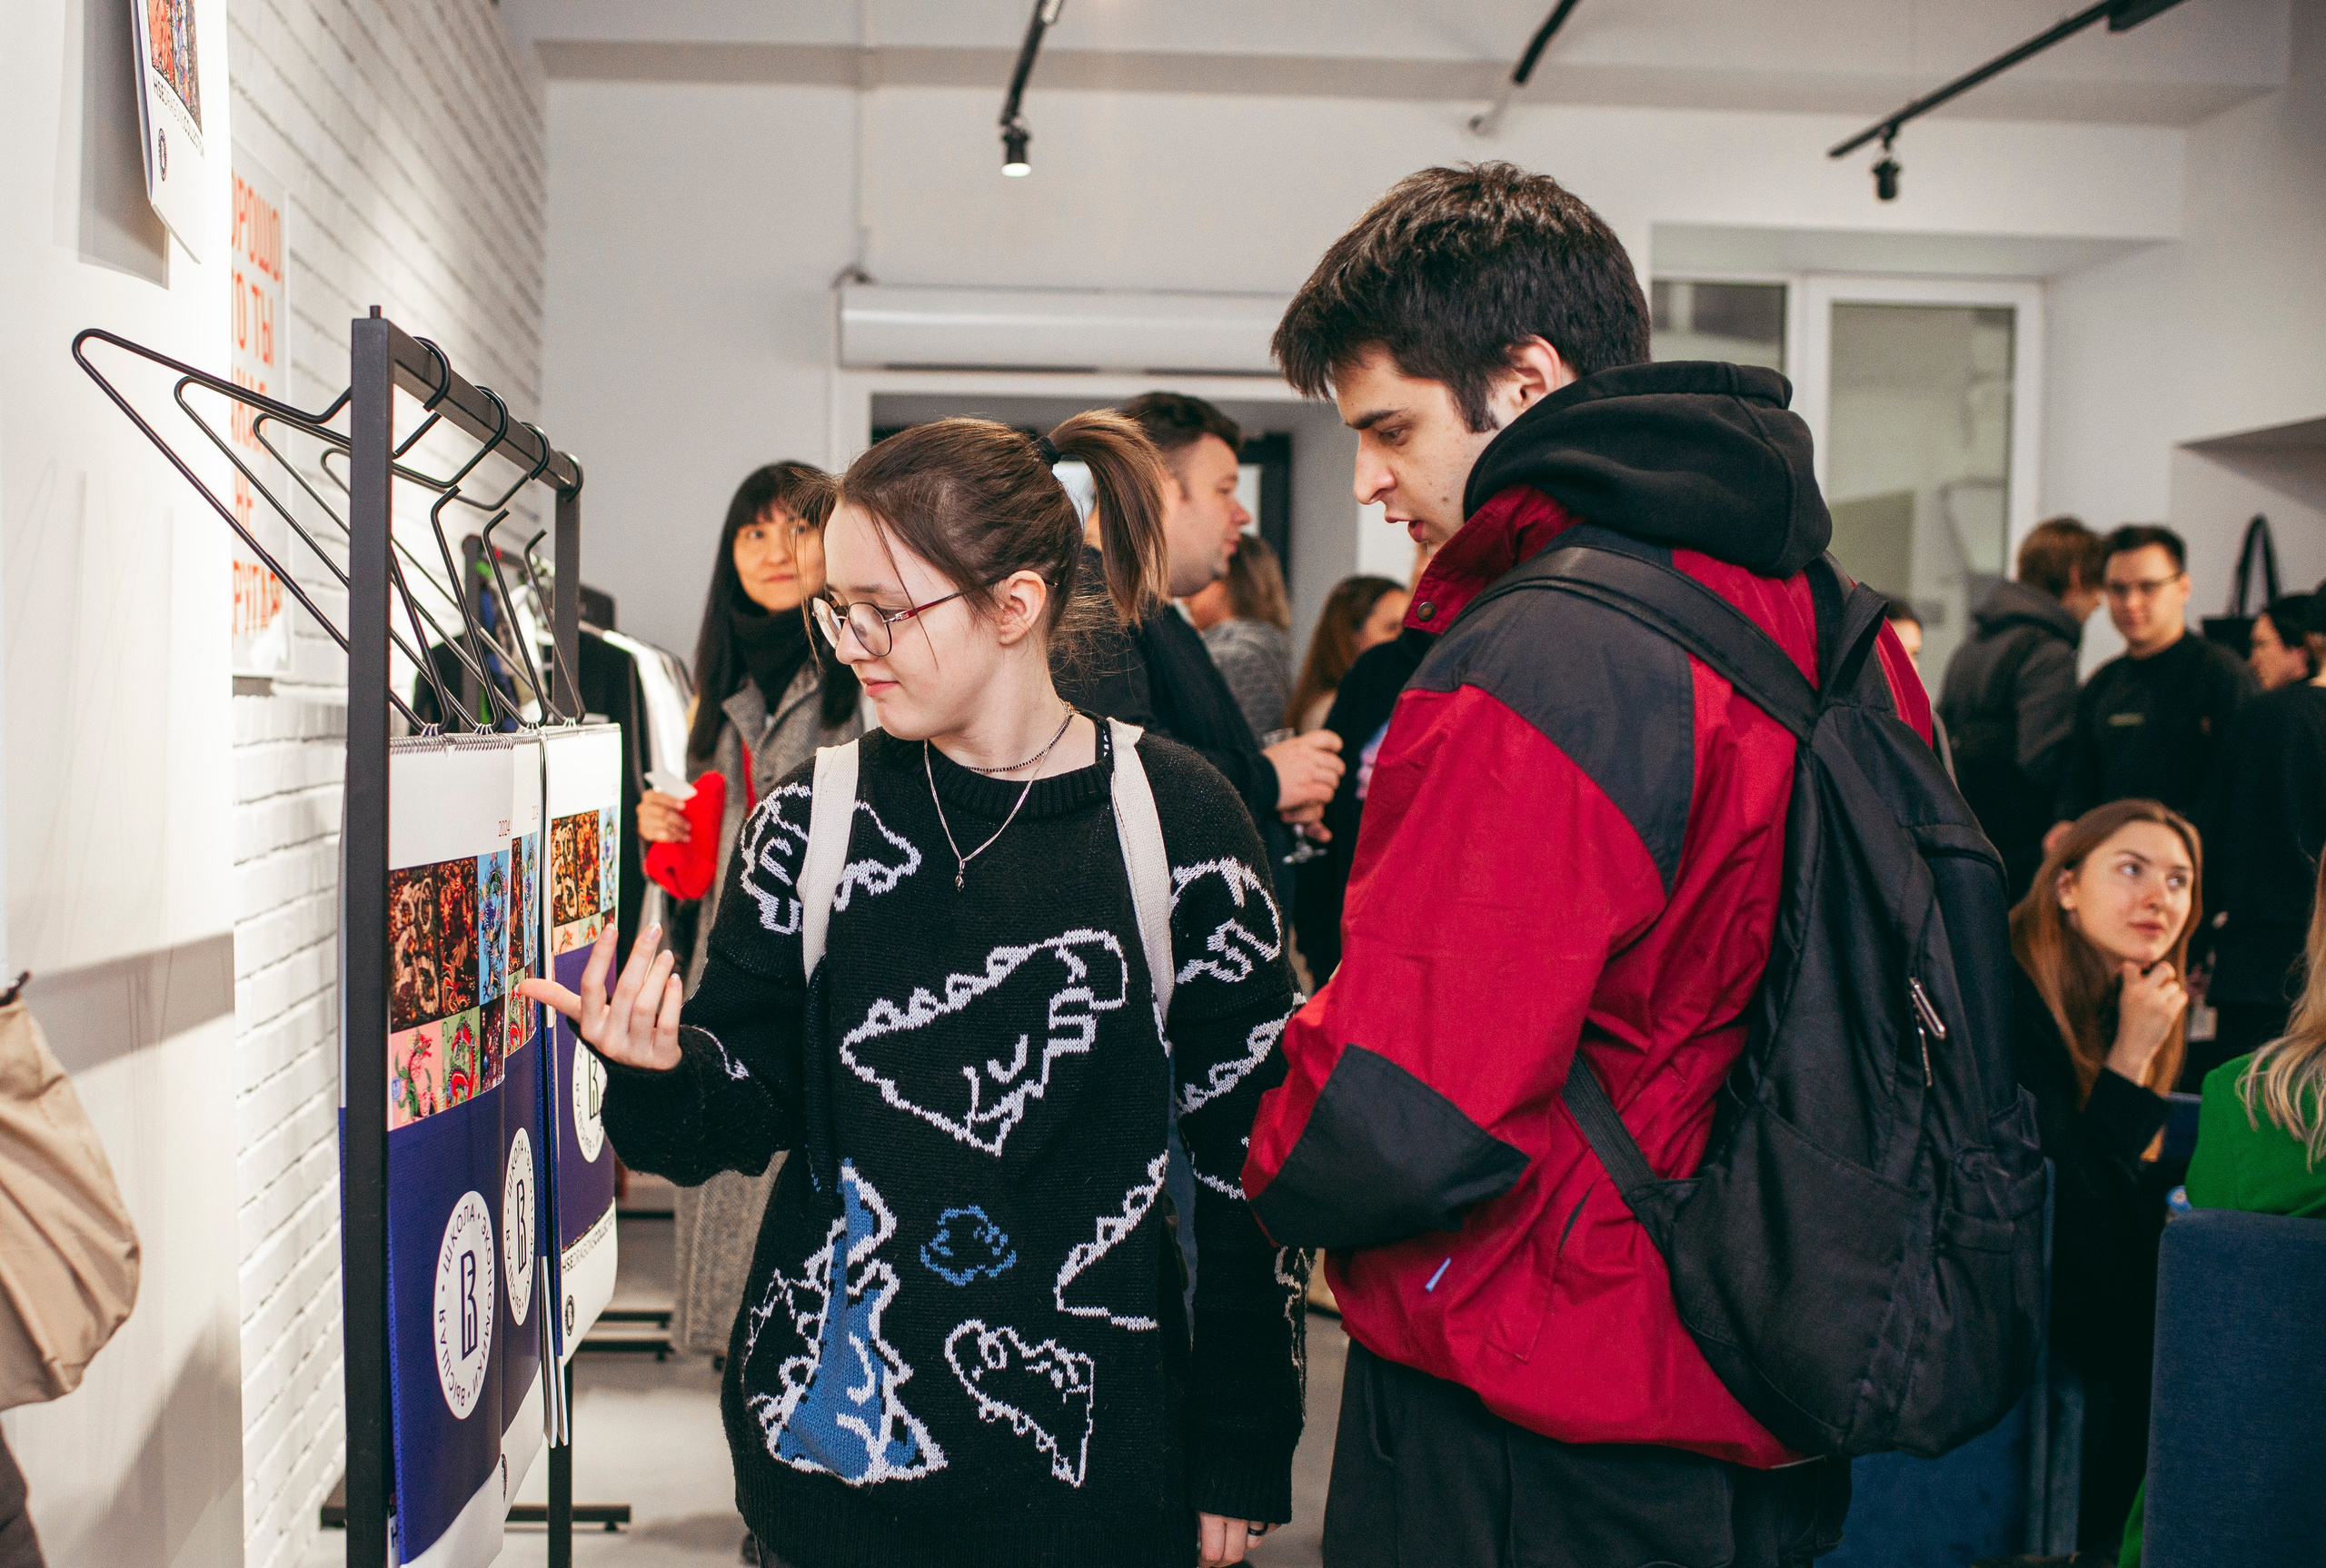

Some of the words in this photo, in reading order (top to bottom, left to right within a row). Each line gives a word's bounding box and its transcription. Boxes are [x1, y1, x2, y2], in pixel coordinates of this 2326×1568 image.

[442, 1203, 475, 1274] ШКОЛА
[472, 1216, 493, 1394] ЭКОНОМИКИ
[438, 1308, 466, 1407] ВЫСШАЯ
